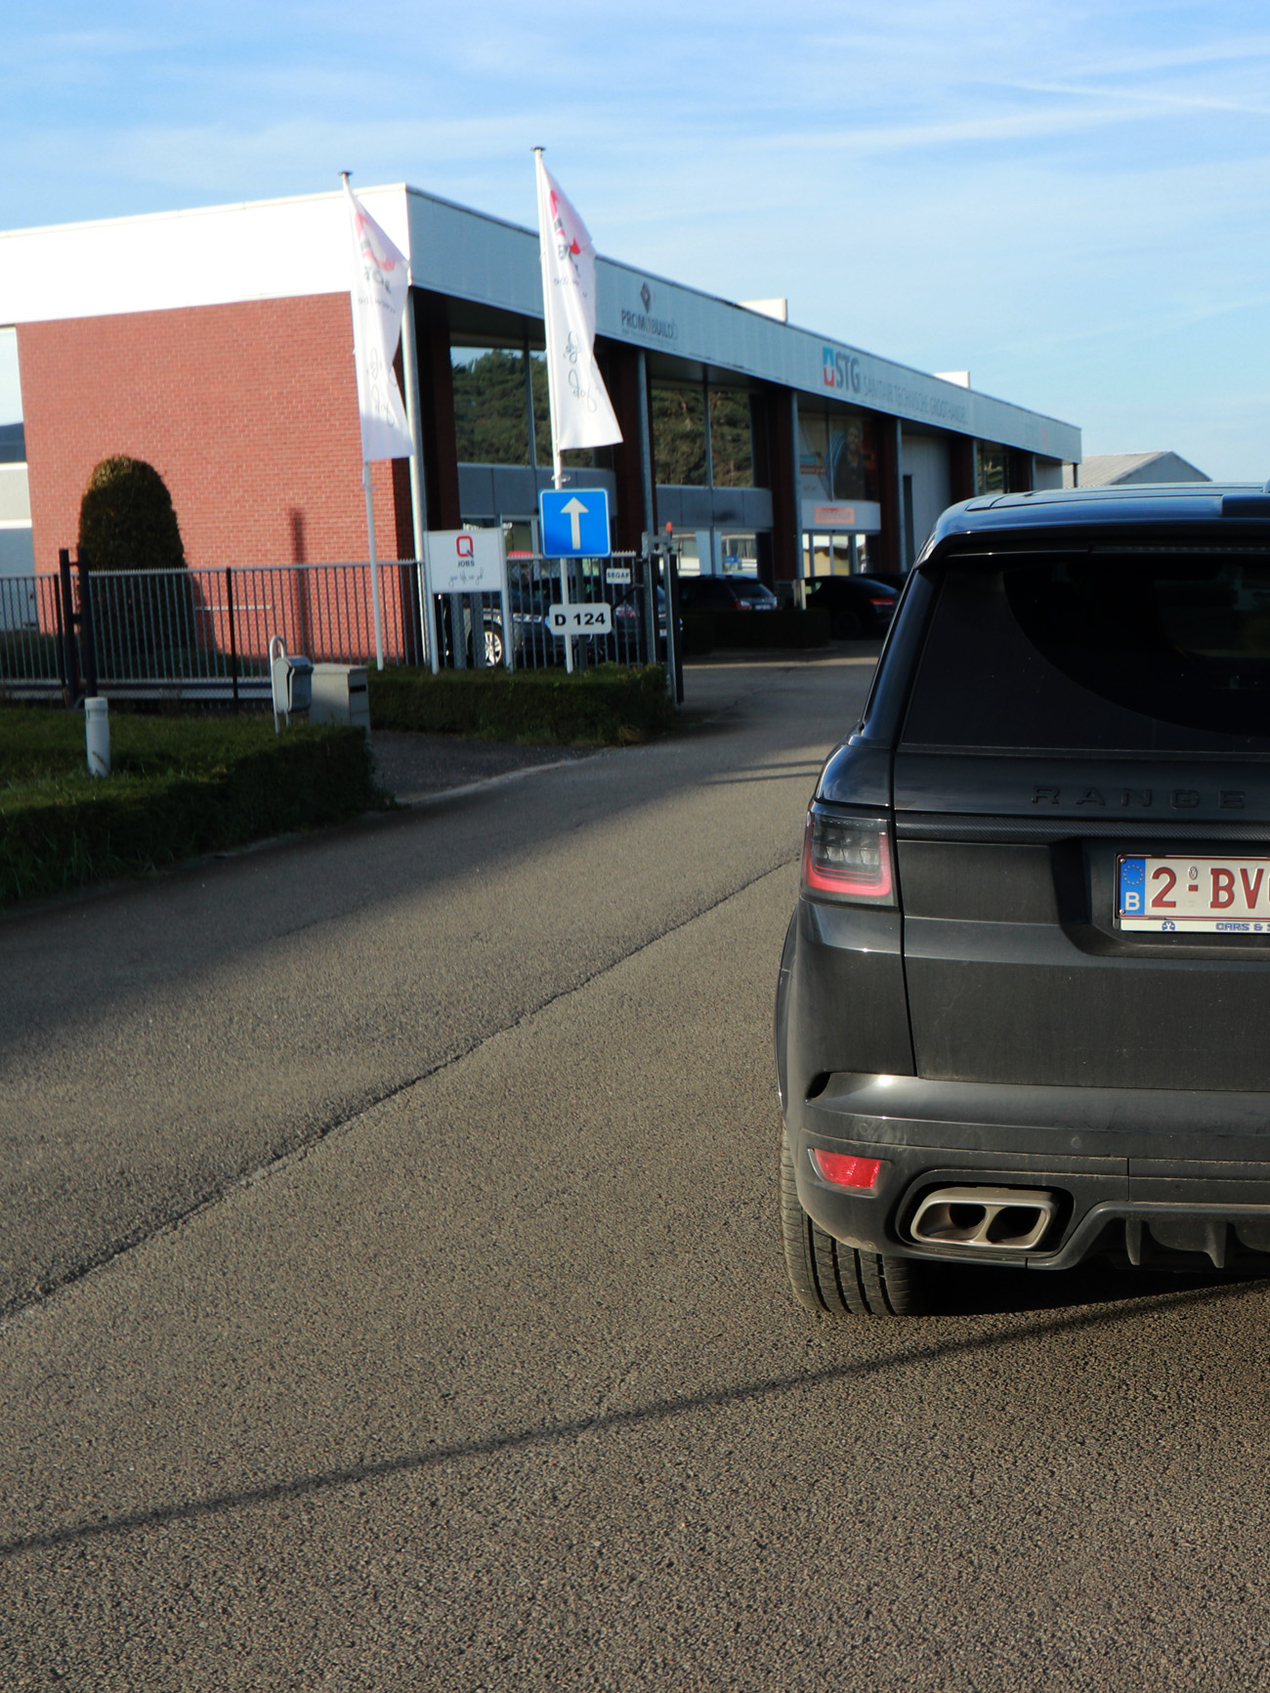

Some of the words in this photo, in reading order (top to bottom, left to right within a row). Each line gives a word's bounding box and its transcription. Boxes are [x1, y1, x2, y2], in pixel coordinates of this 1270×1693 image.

[835, 351, 860, 394] STG
[456, 535, 474, 558] Q
[555, 614, 567, 627] D
[573, 612, 606, 626] 124
[1031, 786, 1247, 810] RANGE
[1125, 891, 1141, 911] B
[1216, 923, 1250, 932] CARS
[1254, 924, 1263, 932] &
